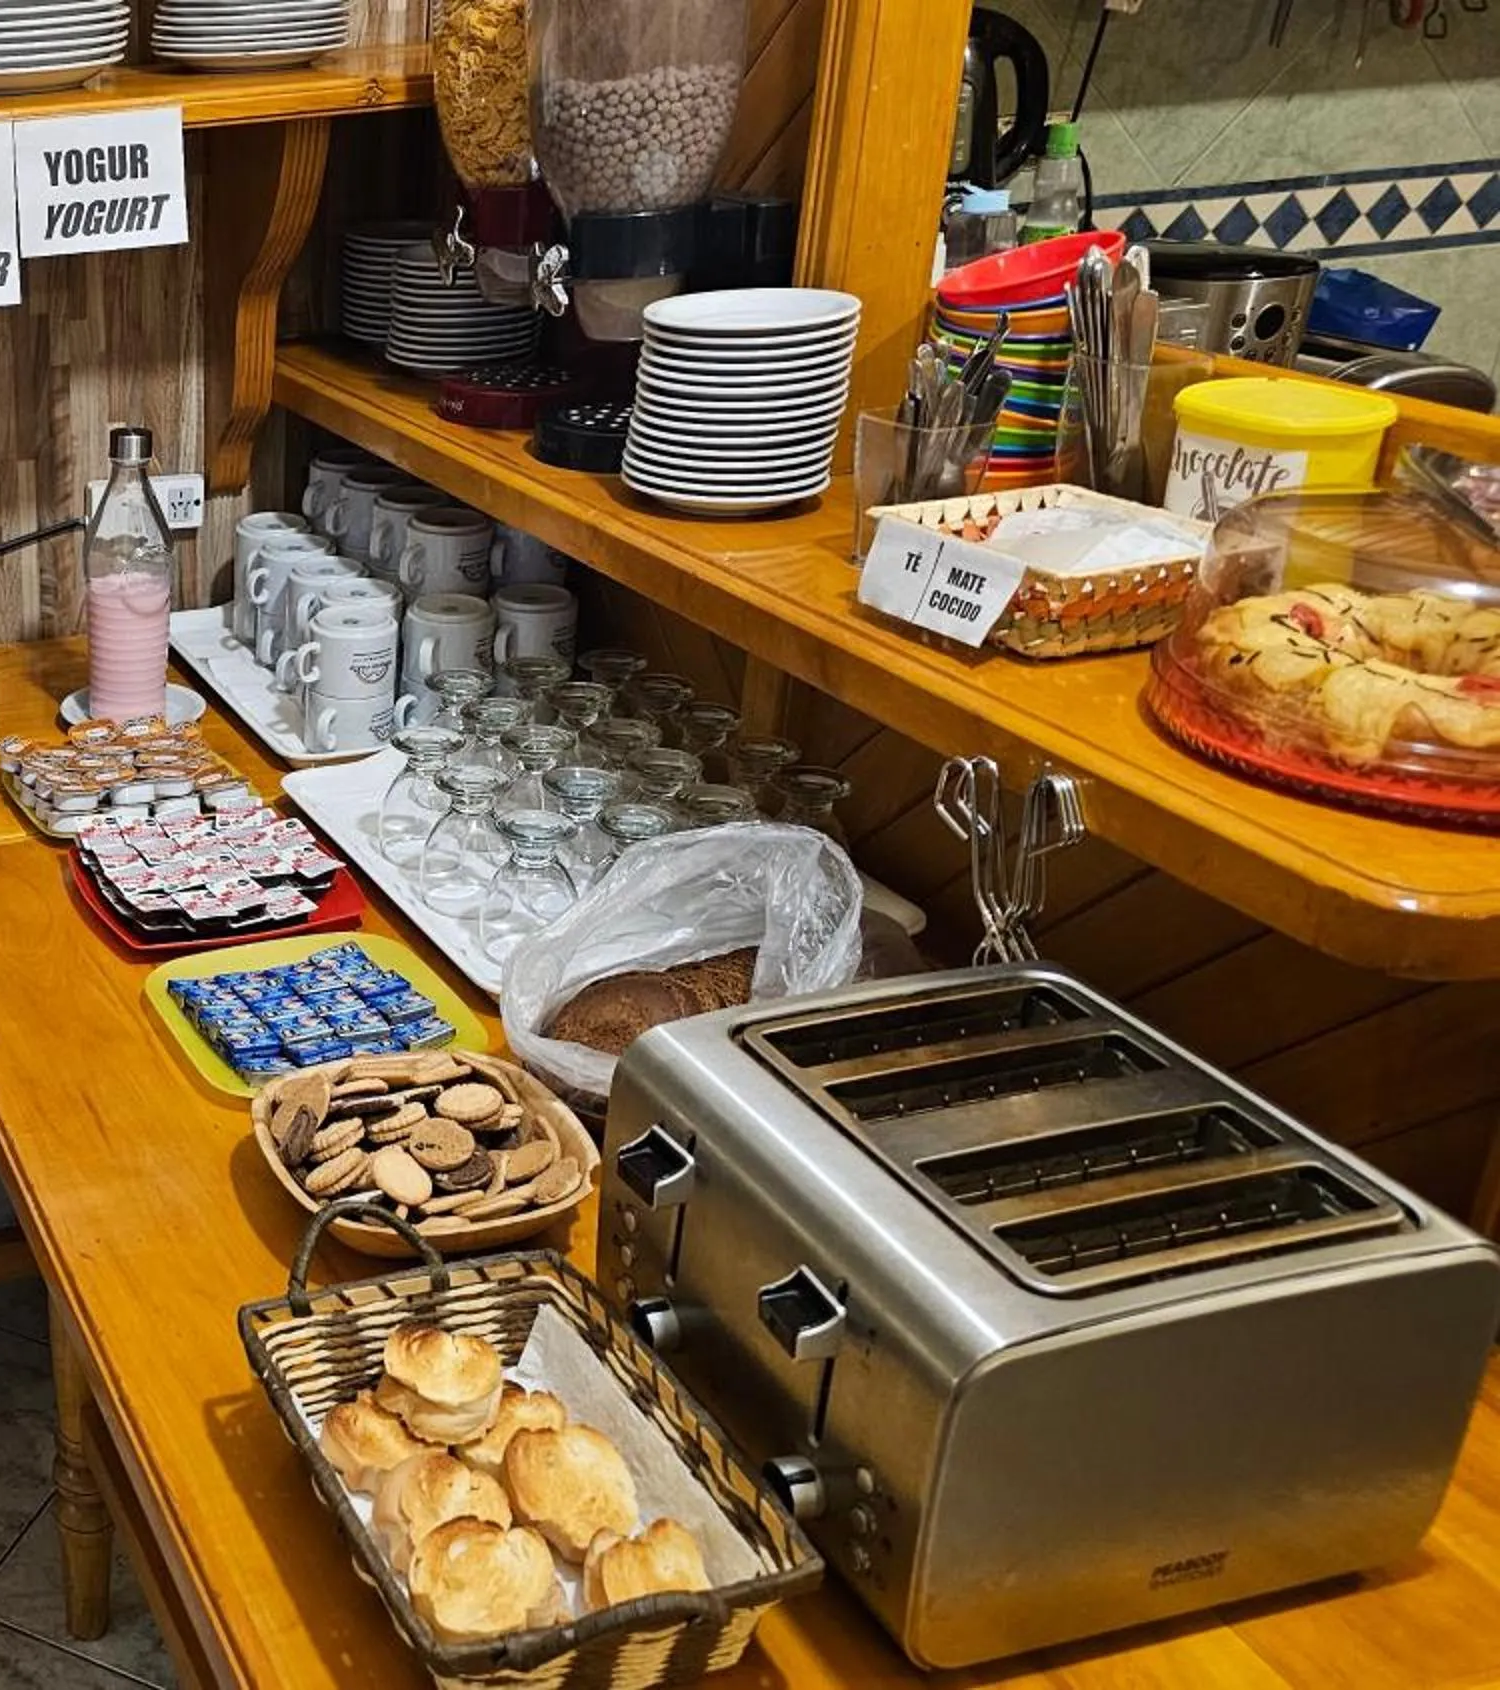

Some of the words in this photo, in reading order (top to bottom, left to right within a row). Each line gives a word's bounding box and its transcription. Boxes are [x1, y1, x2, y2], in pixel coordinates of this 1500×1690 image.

[43, 143, 149, 187] YOGUR
[43, 193, 171, 241] YOGURT
[1173, 438, 1291, 495] hocolate
[904, 550, 924, 573] TÉ
[946, 566, 987, 595] MATE
[928, 589, 982, 622] COCIDO
